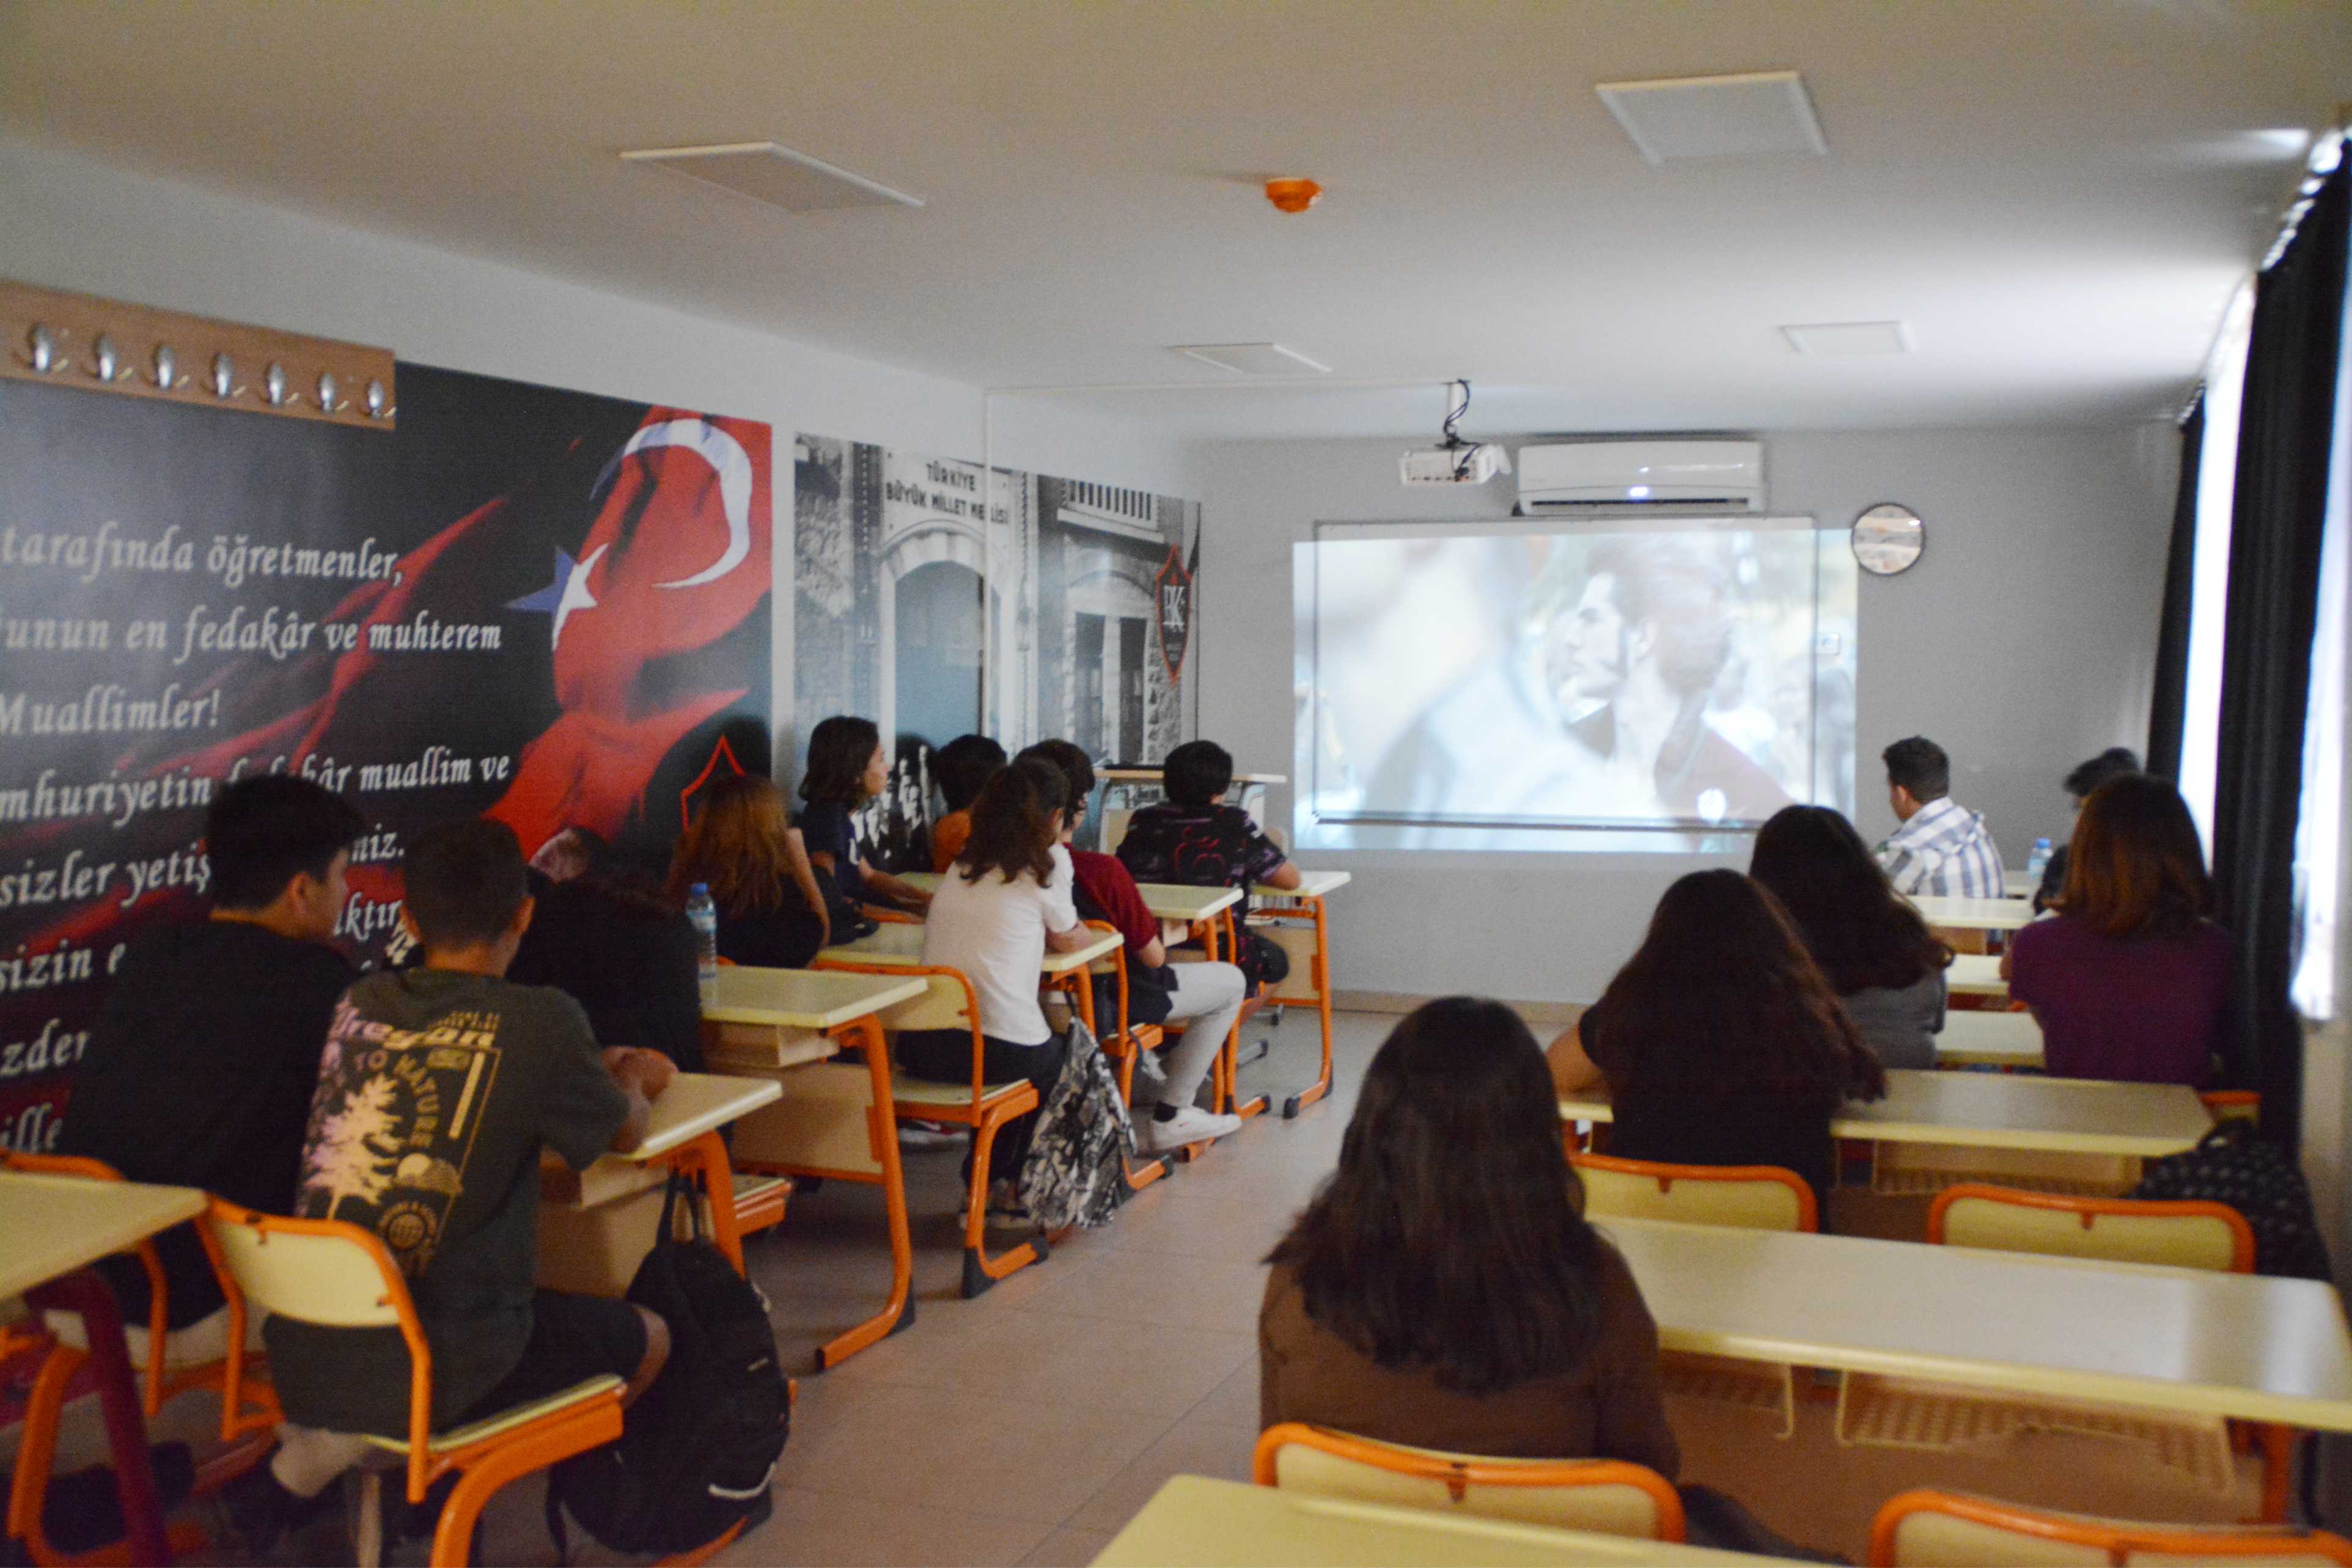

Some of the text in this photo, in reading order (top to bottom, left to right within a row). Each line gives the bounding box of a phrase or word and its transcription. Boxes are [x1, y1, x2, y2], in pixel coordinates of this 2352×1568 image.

[886, 480, 927, 508] BÜYÜK
[971, 502, 1009, 524] MELİSİ
[927, 460, 976, 491] TÜRKİYE
[1, 521, 403, 588] tarafında öğretmenler,
[6, 604, 502, 665] unun en fedakâr ve muhterem
[0, 682, 220, 734] Muallimler!
[0, 766, 213, 829] mhuriyetin
[359, 746, 472, 792] muallim
[479, 755, 511, 783] ve
[0, 850, 117, 909] sizler
